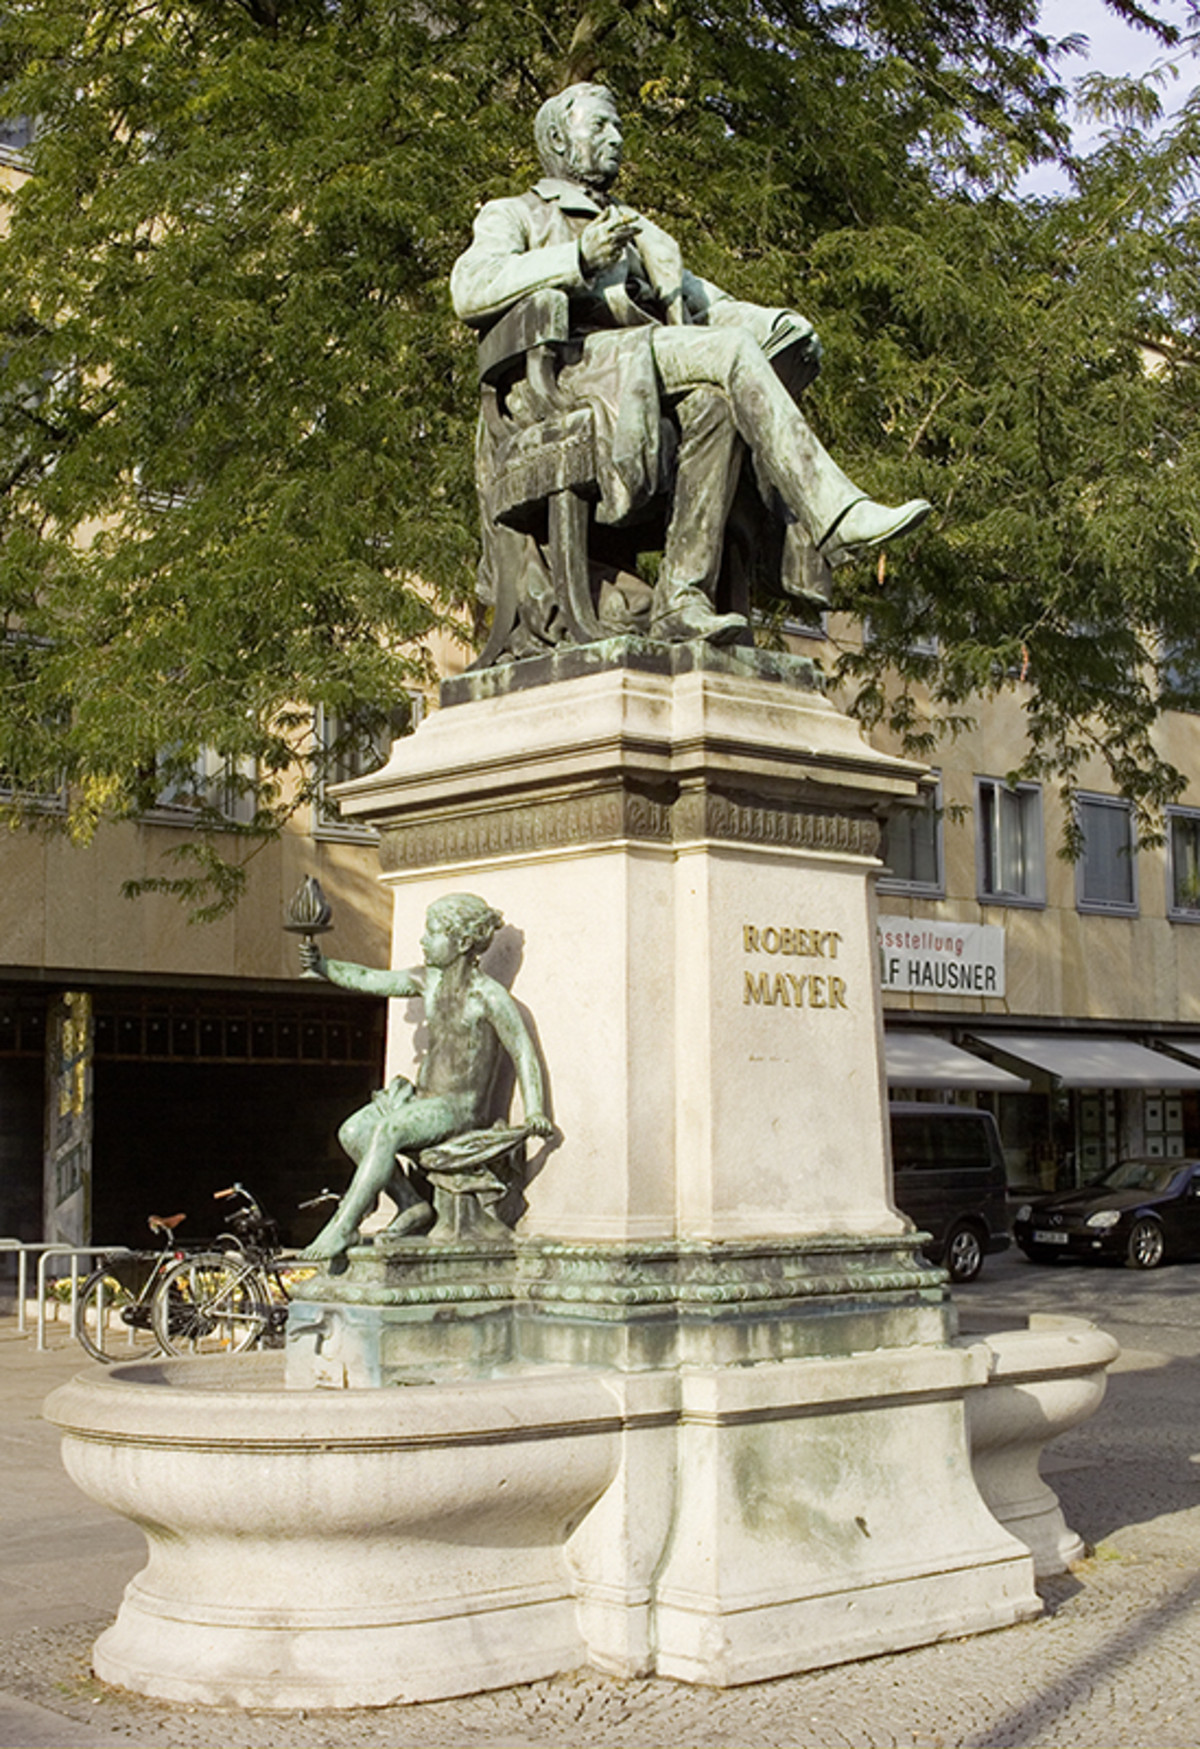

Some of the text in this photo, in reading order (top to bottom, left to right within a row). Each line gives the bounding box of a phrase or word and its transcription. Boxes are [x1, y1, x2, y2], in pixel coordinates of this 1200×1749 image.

[743, 924, 843, 959] ROBERT
[743, 970, 848, 1009] MAYER
[908, 959, 996, 991] HAUSNER
